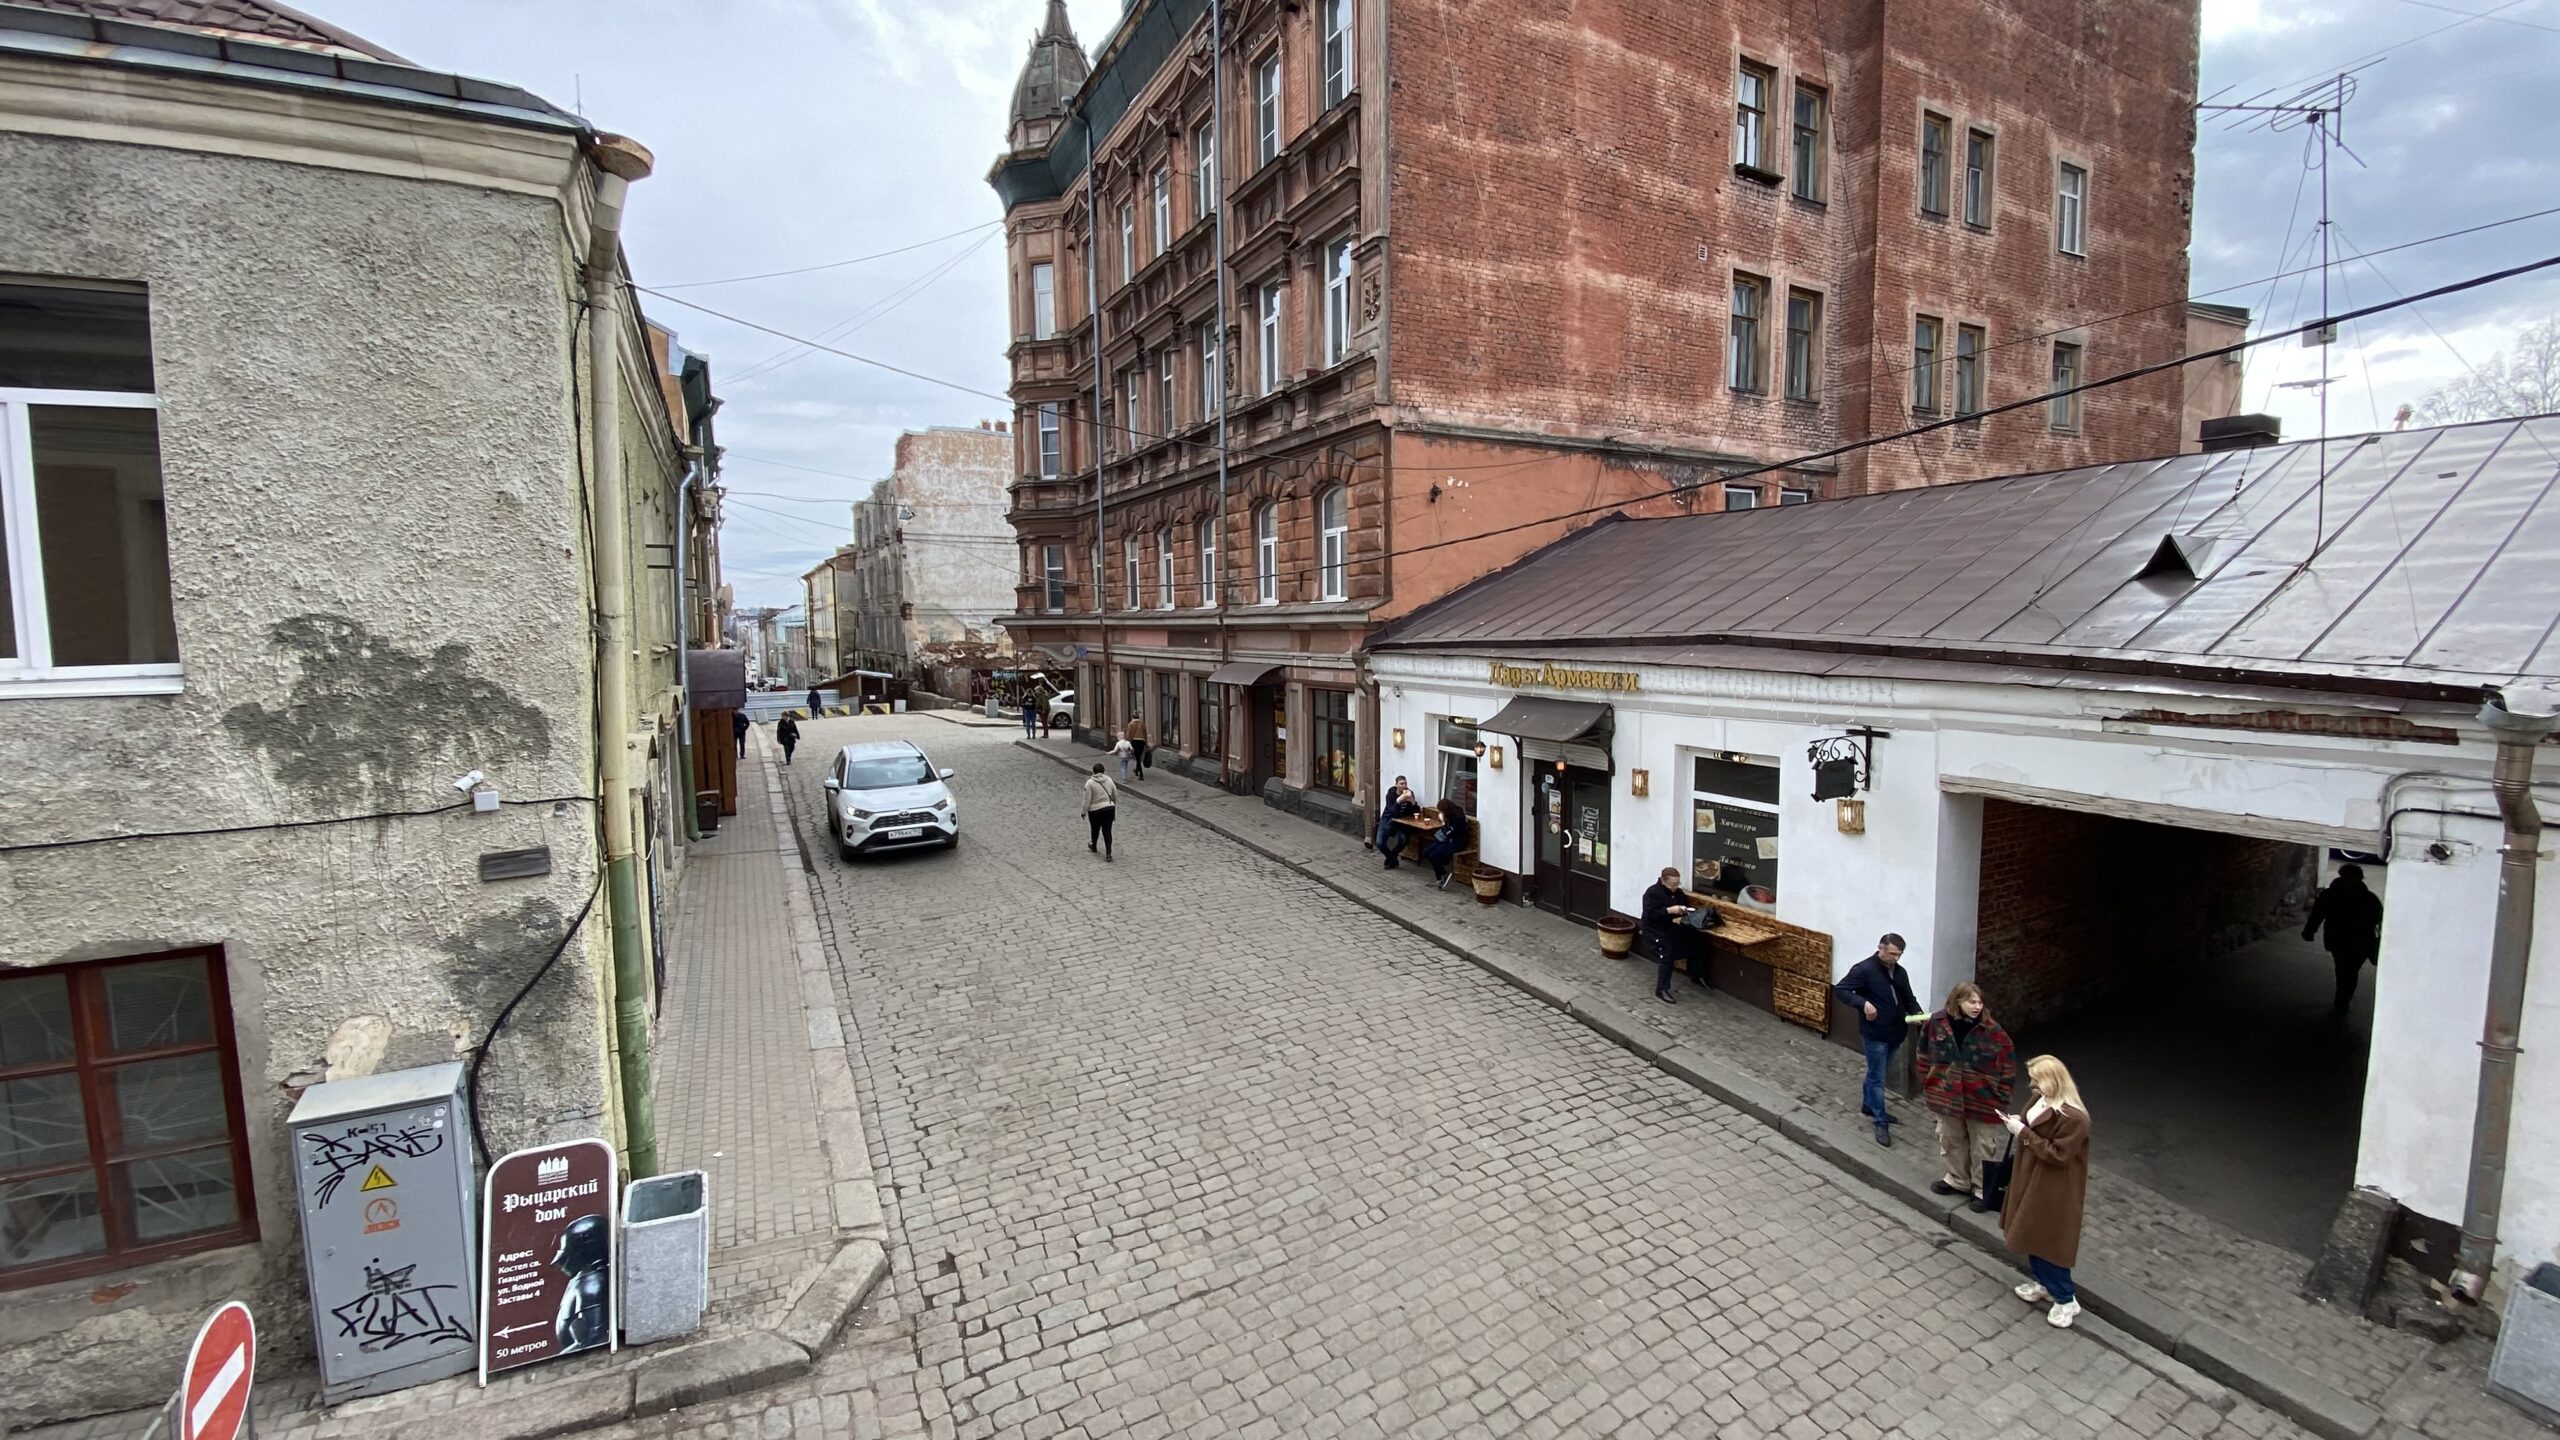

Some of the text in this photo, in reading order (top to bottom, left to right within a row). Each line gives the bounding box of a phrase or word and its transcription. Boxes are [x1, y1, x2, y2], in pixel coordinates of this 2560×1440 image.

[1488, 661, 1640, 691] Дары Армении
[502, 1178, 598, 1213] Рыцарский
[535, 1207, 566, 1223] дом
[498, 1249, 534, 1262] Адрес:
[498, 1262, 528, 1275] Костел
[498, 1271, 538, 1285] Гиацинта
[497, 1278, 545, 1297] ул. Водной
[497, 1289, 541, 1306] Заставы 4
[496, 1340, 548, 1359] 50 метров
